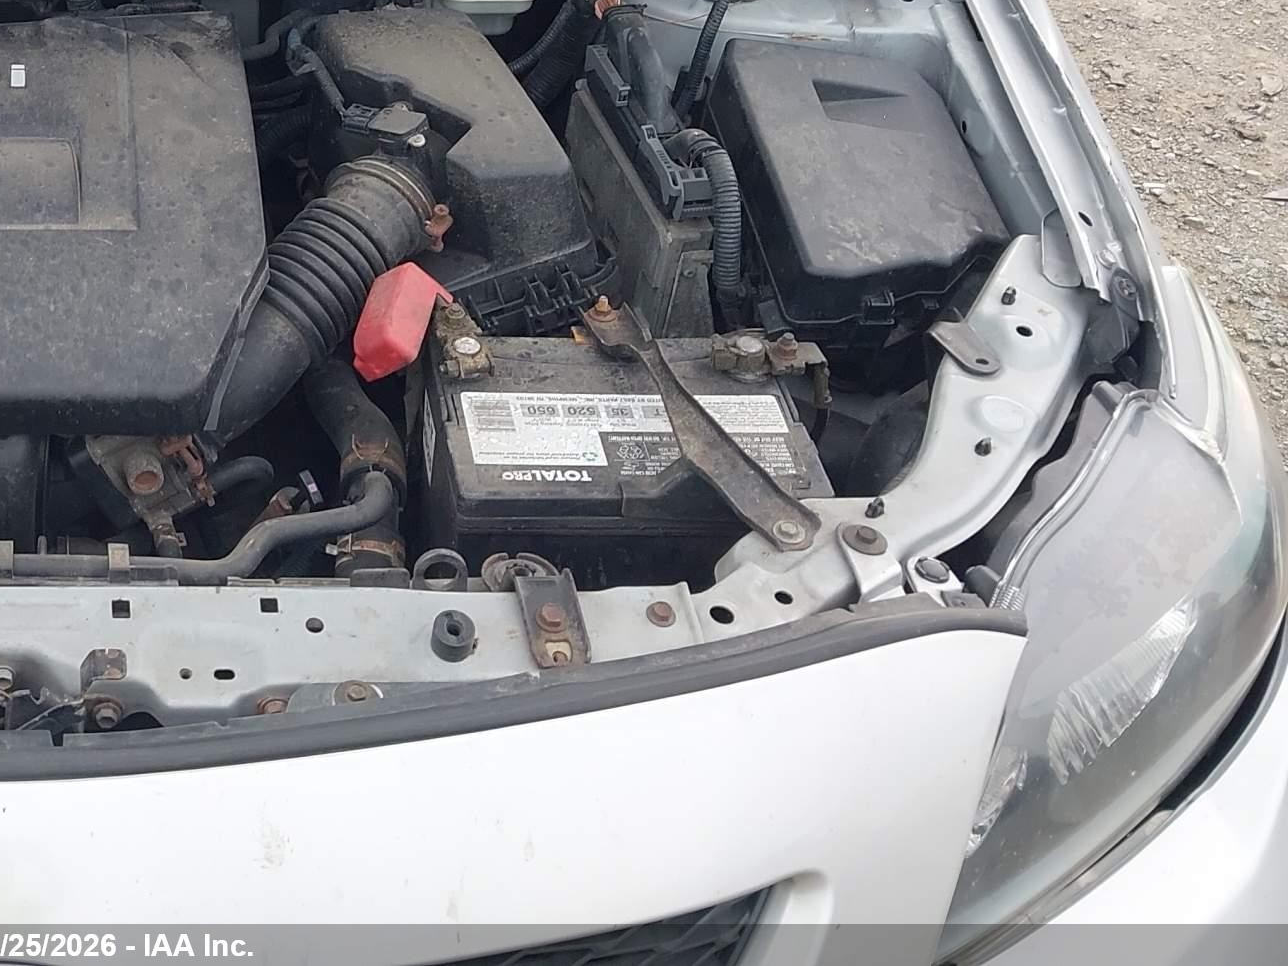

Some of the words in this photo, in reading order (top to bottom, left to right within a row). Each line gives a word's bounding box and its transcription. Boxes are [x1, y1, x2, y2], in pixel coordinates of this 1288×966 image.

[527, 405, 556, 416] 650
[567, 405, 596, 416] 520
[610, 406, 630, 416] 35
[502, 469, 592, 482] TOTALPRO
